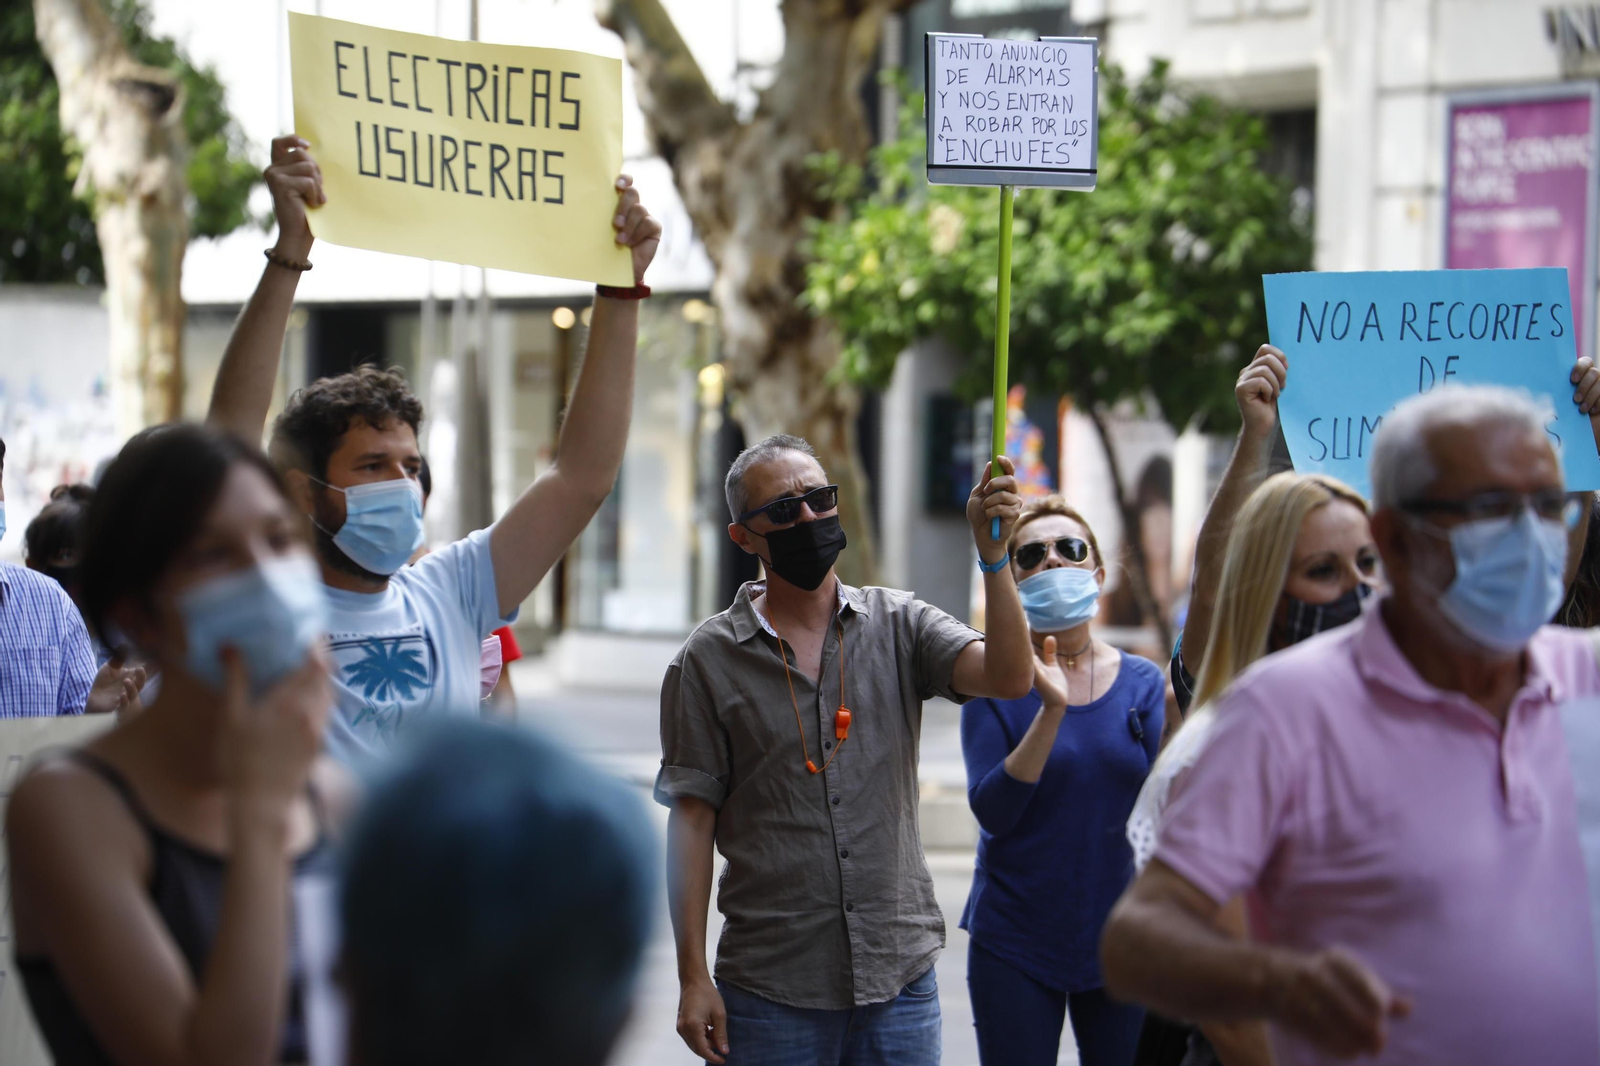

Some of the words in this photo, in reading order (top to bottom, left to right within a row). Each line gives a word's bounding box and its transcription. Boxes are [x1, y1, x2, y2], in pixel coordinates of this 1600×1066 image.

[938, 39, 993, 60] TANTO
[1000, 43, 1068, 65] ANUNCIO
[946, 68, 969, 85] DE
[984, 62, 1071, 87] ALARMAS
[937, 90, 948, 109] Y
[959, 90, 1000, 111] NOS
[1006, 92, 1074, 114] ENTRAN
[941, 115, 953, 132] A
[965, 115, 1023, 134] ROBAR
[1032, 116, 1057, 136] POR
[1064, 117, 1088, 137] LOS
[355, 121, 564, 205] USURERAS
[1297, 301, 1351, 343] NO
[1360, 302, 1384, 342] A
[1400, 301, 1564, 342] RECORTES
